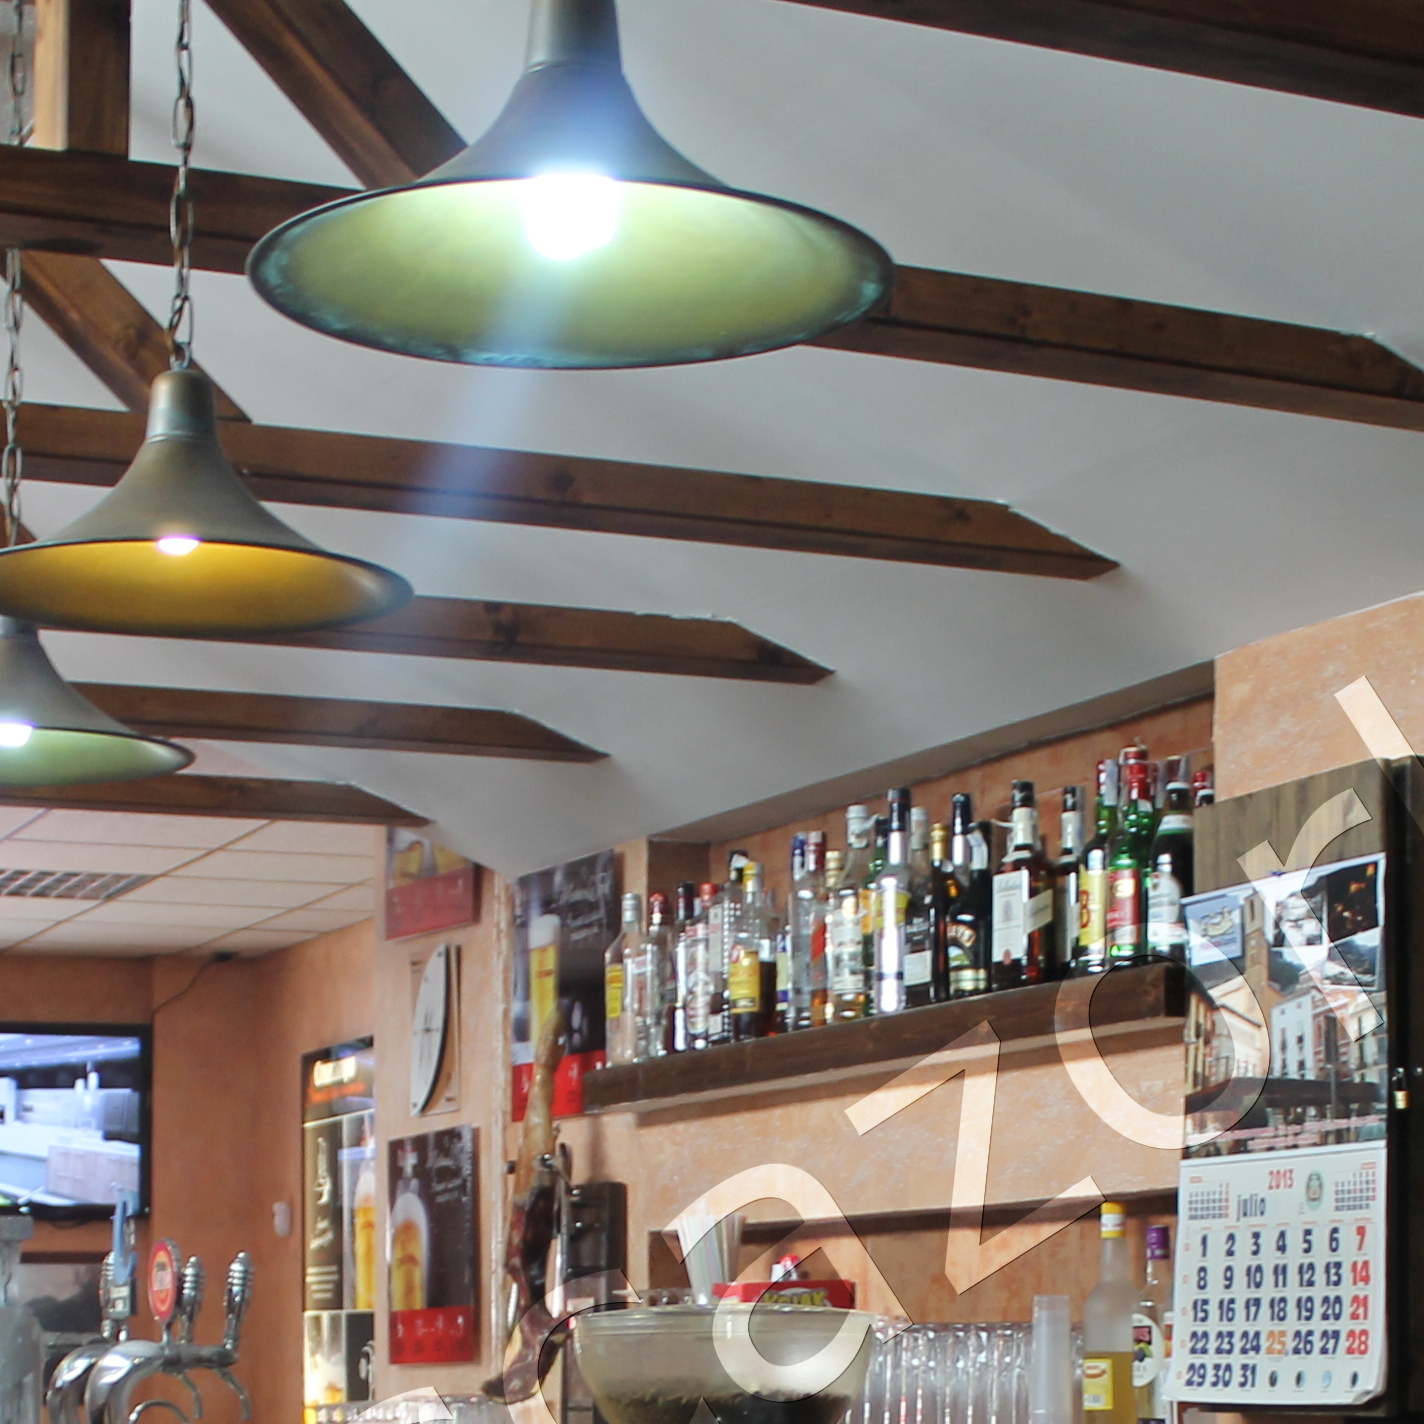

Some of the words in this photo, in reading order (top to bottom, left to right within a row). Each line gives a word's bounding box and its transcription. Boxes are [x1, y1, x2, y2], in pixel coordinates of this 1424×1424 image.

[1267, 1168, 1295, 1190] 2013
[1236, 1193, 1266, 1222] julio
[1200, 1233, 1208, 1258] 1
[1224, 1232, 1236, 1257] 2
[1251, 1231, 1261, 1256] 3
[1276, 1230, 1287, 1254] 4
[1302, 1229, 1313, 1254] 5
[1329, 1227, 1339, 1252] 6
[1356, 1226, 1366, 1251] 7
[1197, 1266, 1208, 1290] 8
[1223, 1265, 1234, 1289] 9
[1246, 1264, 1264, 1289] 10
[1273, 1263, 1288, 1288] 11
[1298, 1262, 1315, 1287] 12
[1324, 1261, 1343, 1286] 13
[1351, 1260, 1370, 1286] 14
[1192, 1298, 1209, 1322] 15
[1218, 1298, 1236, 1322] 16
[1245, 1297, 1261, 1322] 17
[1269, 1297, 1287, 1321] 18
[1296, 1296, 1314, 1321] 19
[1321, 1295, 1343, 1321] 20
[1349, 1294, 1369, 1320] 21
[1189, 1330, 1209, 1355] 22
[1214, 1330, 1235, 1355] 23
[1239, 1330, 1261, 1354] 24
[1266, 1330, 1287, 1354] 25
[1292, 1330, 1314, 1355] 26
[1319, 1329, 1341, 1355] 27
[1345, 1329, 1369, 1355] 28
[1185, 1363, 1207, 1387] 29
[1210, 1363, 1232, 1387] 30
[1238, 1363, 1257, 1388] 31
